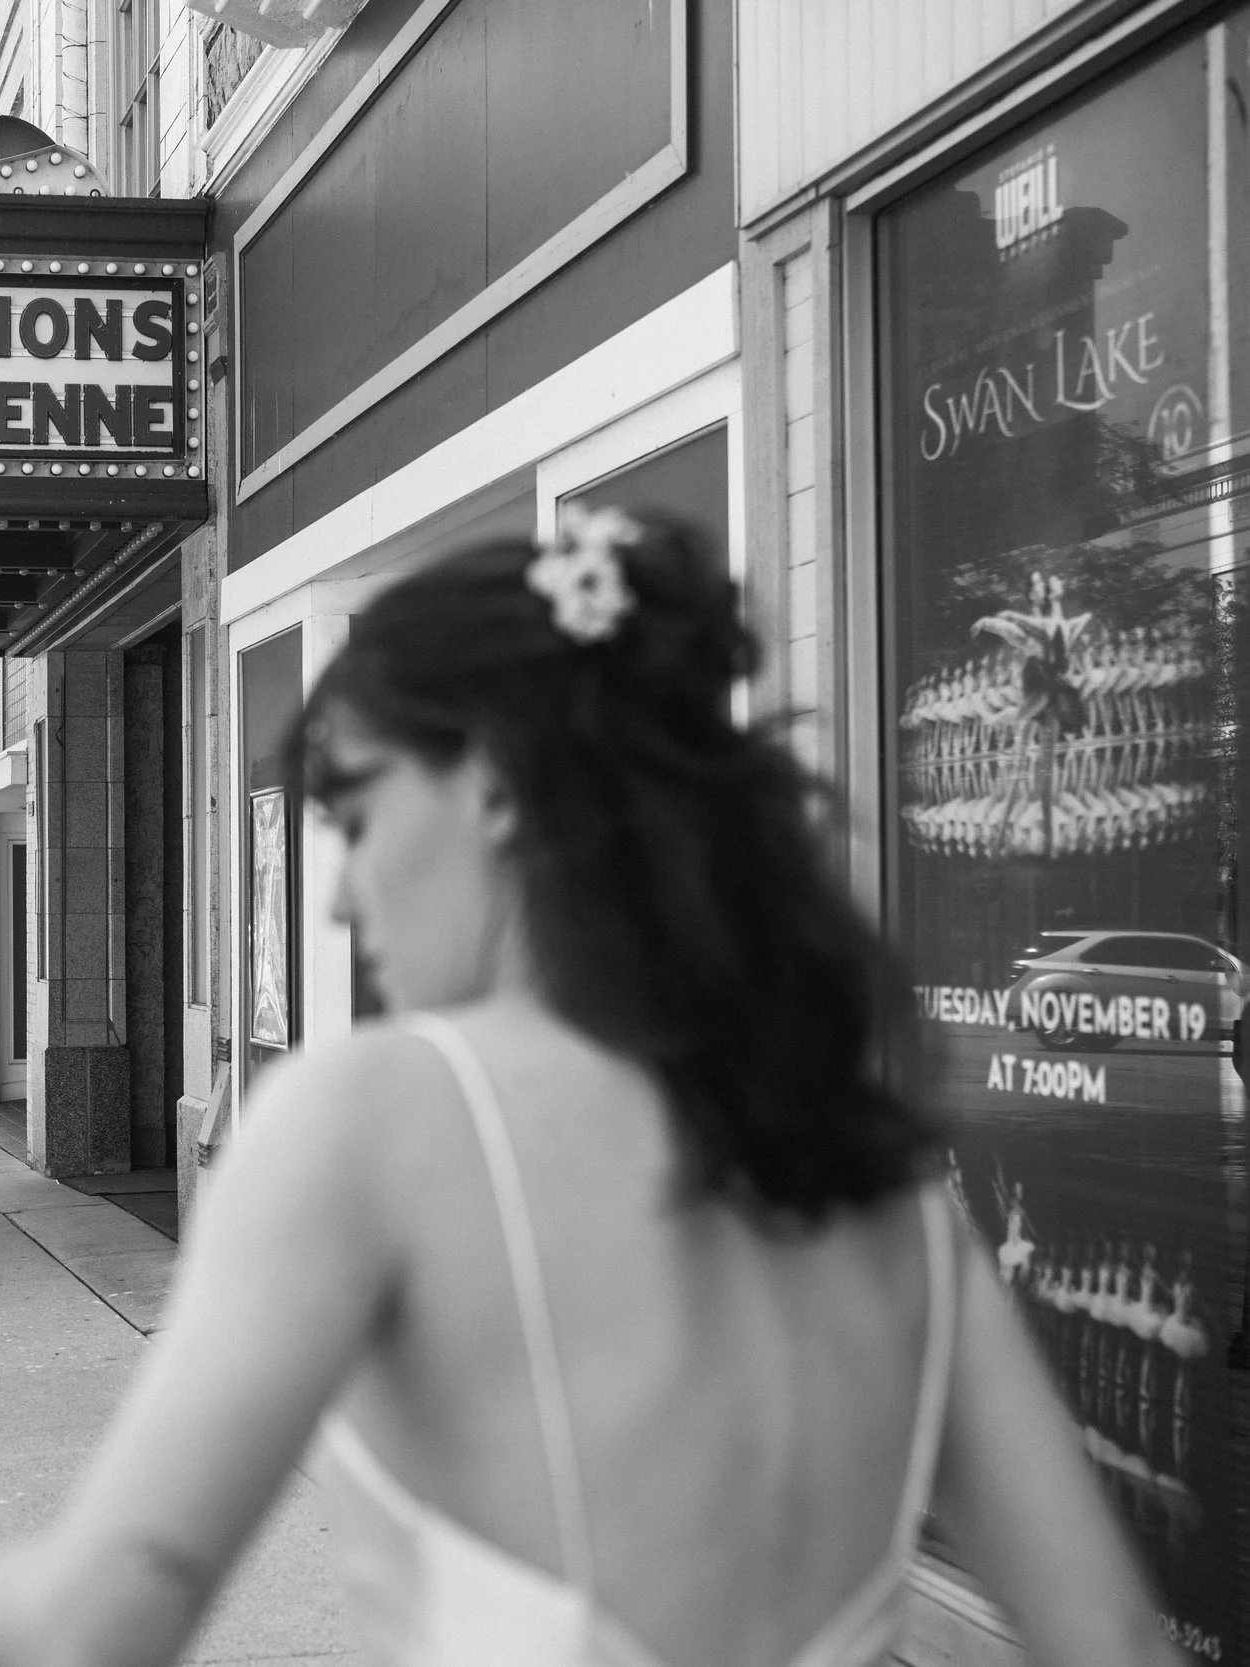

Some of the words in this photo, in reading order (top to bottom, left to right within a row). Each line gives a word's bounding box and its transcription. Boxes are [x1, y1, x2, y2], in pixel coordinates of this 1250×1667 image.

[921, 365, 1045, 460] SWAN
[1055, 313, 1164, 410] LAKE
[913, 986, 1015, 1032] TUESDAY,
[1021, 991, 1171, 1040] NOVEMBER
[1179, 1003, 1207, 1041] 19
[987, 1054, 1016, 1092] AT
[1021, 1060, 1106, 1104] 7:00PM
